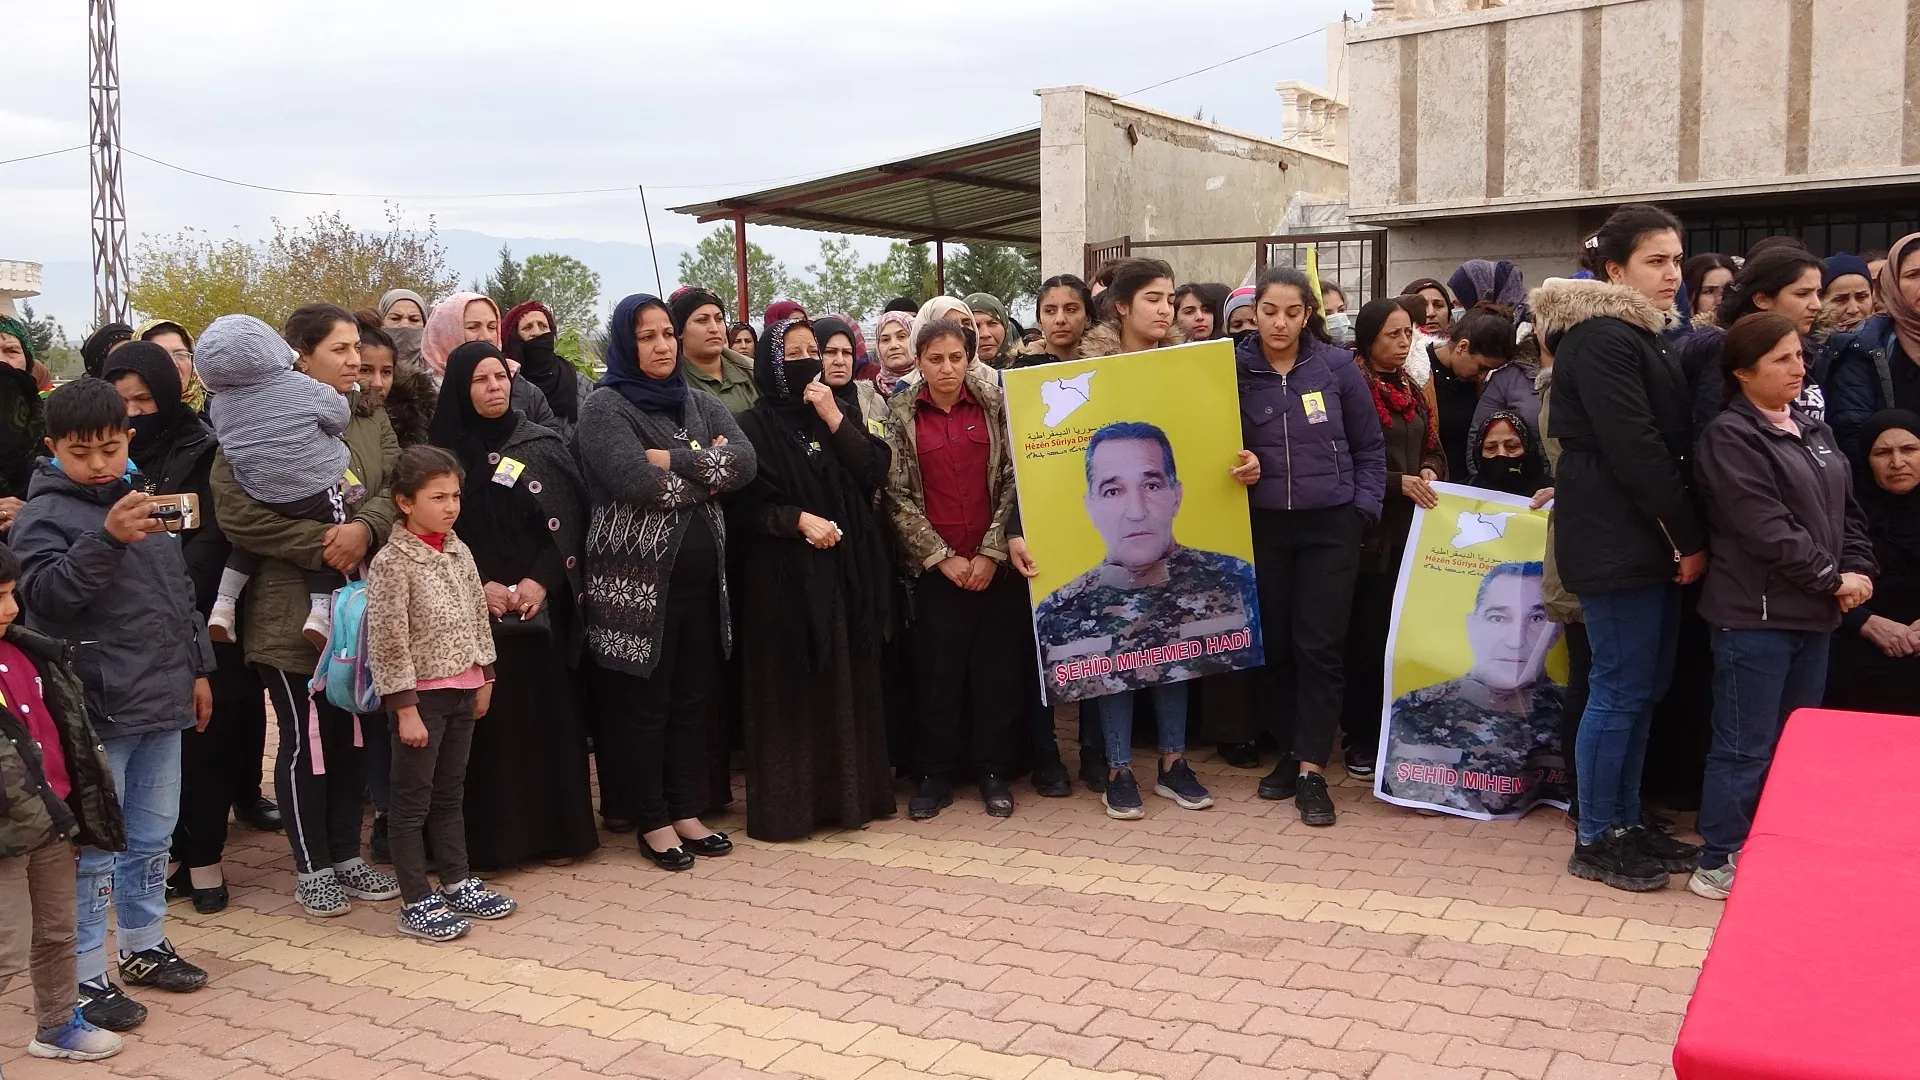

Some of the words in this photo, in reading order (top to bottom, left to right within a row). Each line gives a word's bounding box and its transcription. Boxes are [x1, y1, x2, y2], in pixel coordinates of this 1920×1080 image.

[1025, 440, 1050, 451] Hêzên
[1051, 436, 1076, 447] Sûriya
[1452, 559, 1477, 569] Sûriya
[1055, 655, 1112, 686] ŞEHÎD
[1116, 641, 1202, 672] MIHEMED
[1206, 627, 1251, 654] HADÎ
[1397, 763, 1458, 786] ŞEHÎD
